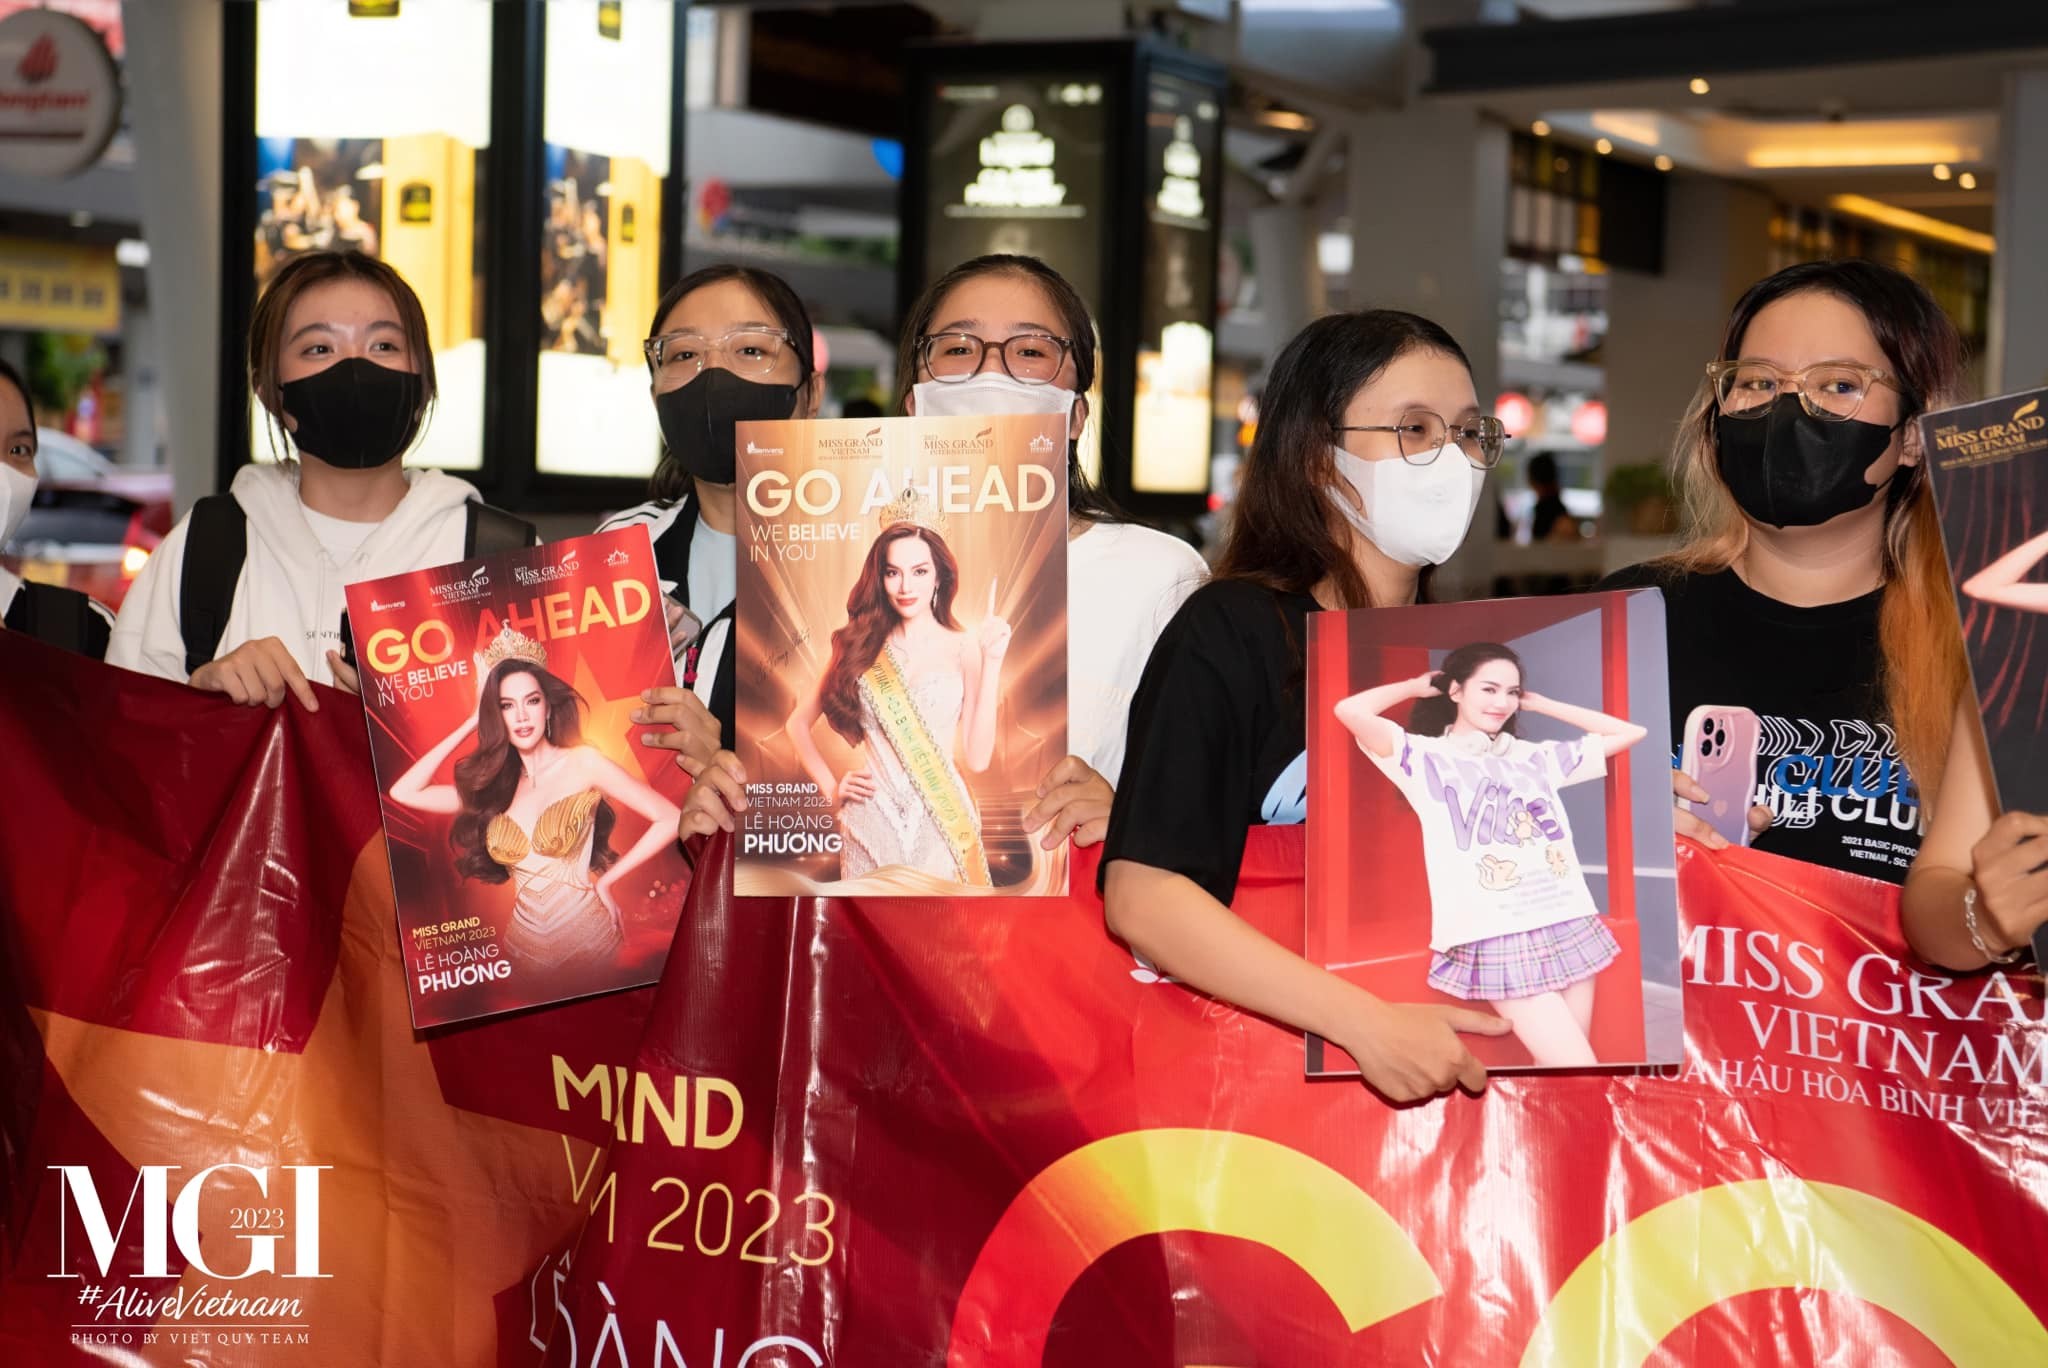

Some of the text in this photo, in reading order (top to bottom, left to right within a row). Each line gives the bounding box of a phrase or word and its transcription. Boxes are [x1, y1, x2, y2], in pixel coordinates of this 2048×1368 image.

[844, 438, 883, 447] GRAND
[924, 439, 993, 449] MISS GRAND
[1936, 430, 1979, 450] MISS
[1979, 416, 2046, 439] GRAND
[747, 464, 1055, 517] GO AHEAD
[750, 523, 861, 542] WE BELIEVE
[750, 544, 816, 562] IN YOU
[514, 561, 580, 583] MISS GRAND
[430, 576, 489, 596] MISS GRAND
[366, 578, 653, 674] GO AHEAD
[374, 661, 469, 691] WE BELIEVE
[377, 685, 435, 708] IN YOU
[746, 783, 818, 794] MISS GRAND
[746, 796, 833, 808] VIETNAM 2023
[744, 811, 833, 830] LÊ HOÀNG
[744, 831, 843, 854] PHƯƠNG
[412, 916, 480, 939] MISS GRAND
[414, 926, 497, 951] VIETNAM 2023
[416, 943, 499, 972] LÊ HOÀNG
[418, 959, 512, 995] PHƯƠNG
[1846, 952, 2048, 1023] GRA
[1738, 999, 2048, 1090] VIETNAM
[1720, 1054, 1793, 1097] HẬU
[1802, 1068, 1872, 1107] HÒA
[1879, 1080, 1965, 1123] BÌNH
[647, 1176, 835, 1267] 2023
